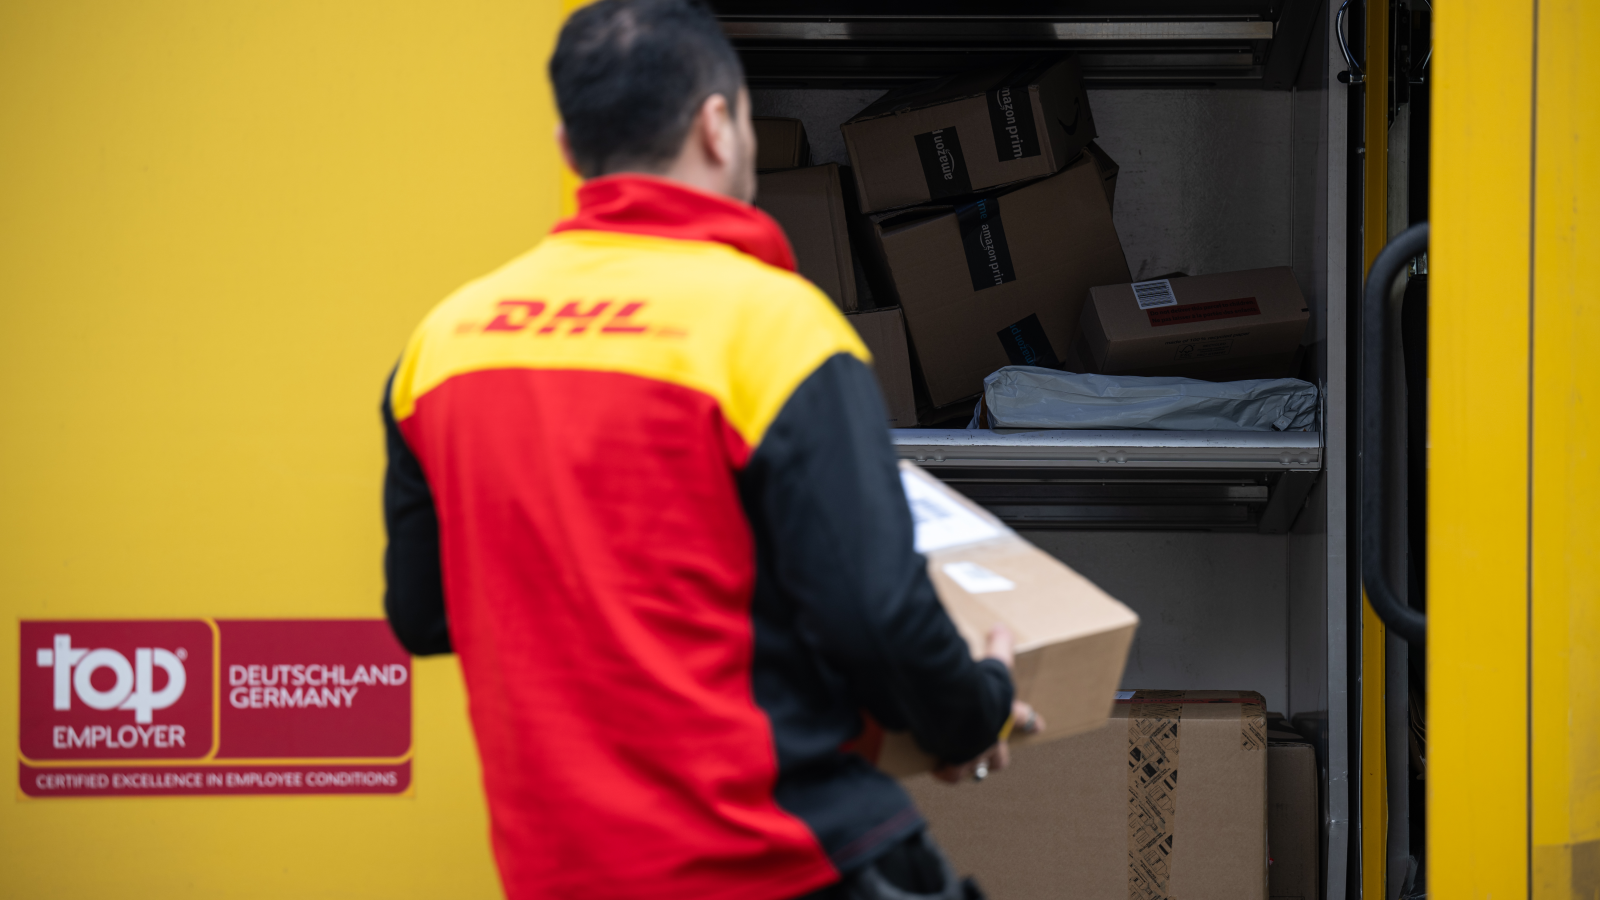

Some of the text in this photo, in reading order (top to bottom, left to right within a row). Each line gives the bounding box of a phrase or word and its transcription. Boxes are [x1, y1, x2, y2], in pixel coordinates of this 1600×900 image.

[1001, 86, 1024, 160] mazon prim
[933, 136, 953, 181] amazon
[976, 198, 988, 220] ime
[981, 224, 997, 262] amazon
[482, 299, 647, 334] DHL
[1204, 304, 1221, 312] parcel
[1014, 334, 1036, 366] mazon
[228, 664, 408, 686] DEUTSCHLAND
[229, 687, 358, 709] GERMANY
[53, 725, 186, 748] EMPLOYER
[36, 771, 398, 790] CERTIFIED EXCELLENCE IN EMPLOYEE CONDITIONS
